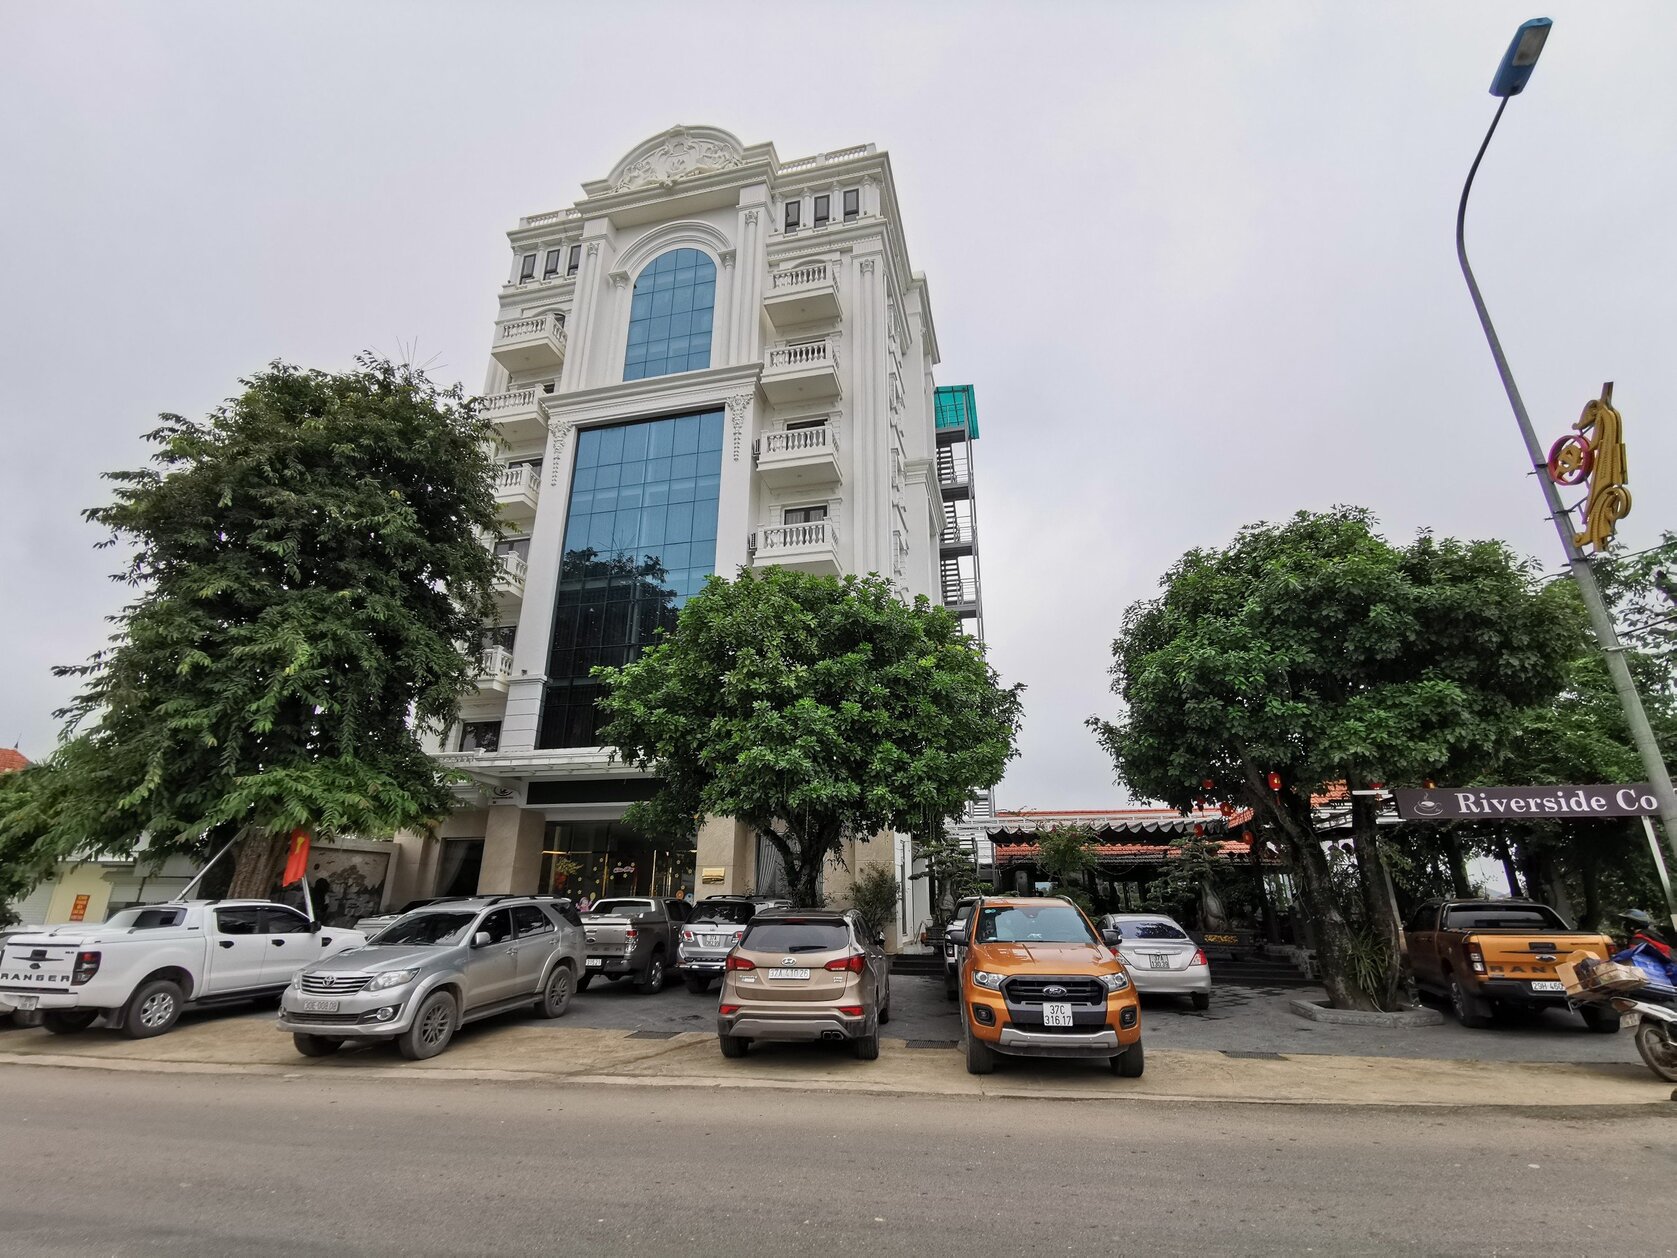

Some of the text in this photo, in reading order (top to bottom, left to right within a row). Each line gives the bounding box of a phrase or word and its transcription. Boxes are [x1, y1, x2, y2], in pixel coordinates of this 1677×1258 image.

[1454, 789, 1658, 814] Riverside Co
[0, 973, 70, 982] RANGER
[1050, 1004, 1065, 1014] 37C
